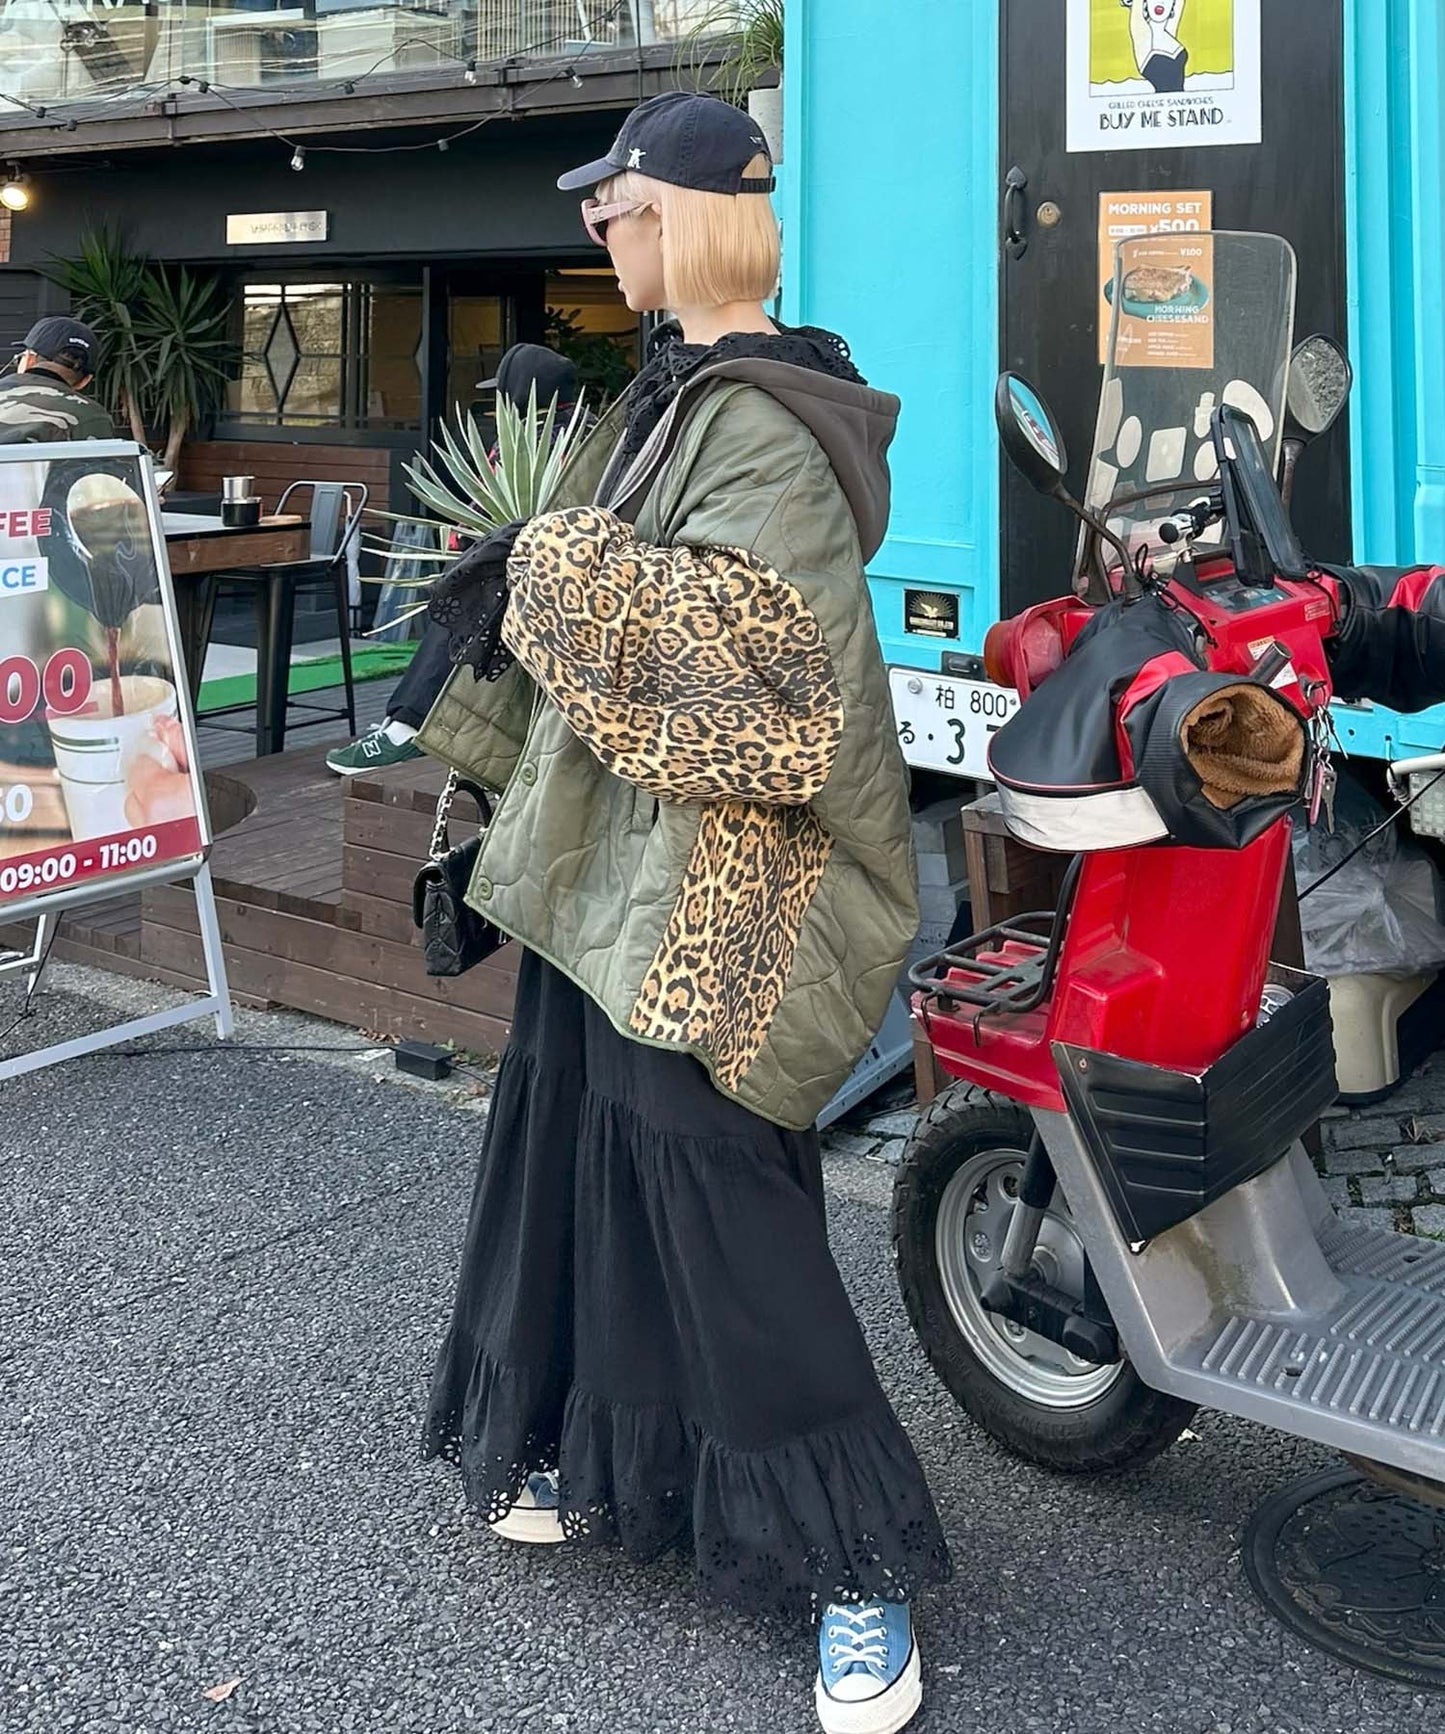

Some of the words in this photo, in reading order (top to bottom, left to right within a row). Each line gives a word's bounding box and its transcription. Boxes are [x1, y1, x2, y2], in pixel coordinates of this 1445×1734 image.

[1100, 112, 1135, 130] BUY
[1141, 110, 1161, 128] ME
[1167, 107, 1224, 127] STAND
[1108, 203, 1171, 214] MORNING
[1176, 202, 1202, 213] SET
[1154, 304, 1199, 314] MORNING
[935, 684, 955, 710] 柏
[970, 690, 1008, 718] 800
[361, 740, 381, 758] N
[0, 853, 77, 892] 09:00
[100, 834, 158, 869] 11:00
